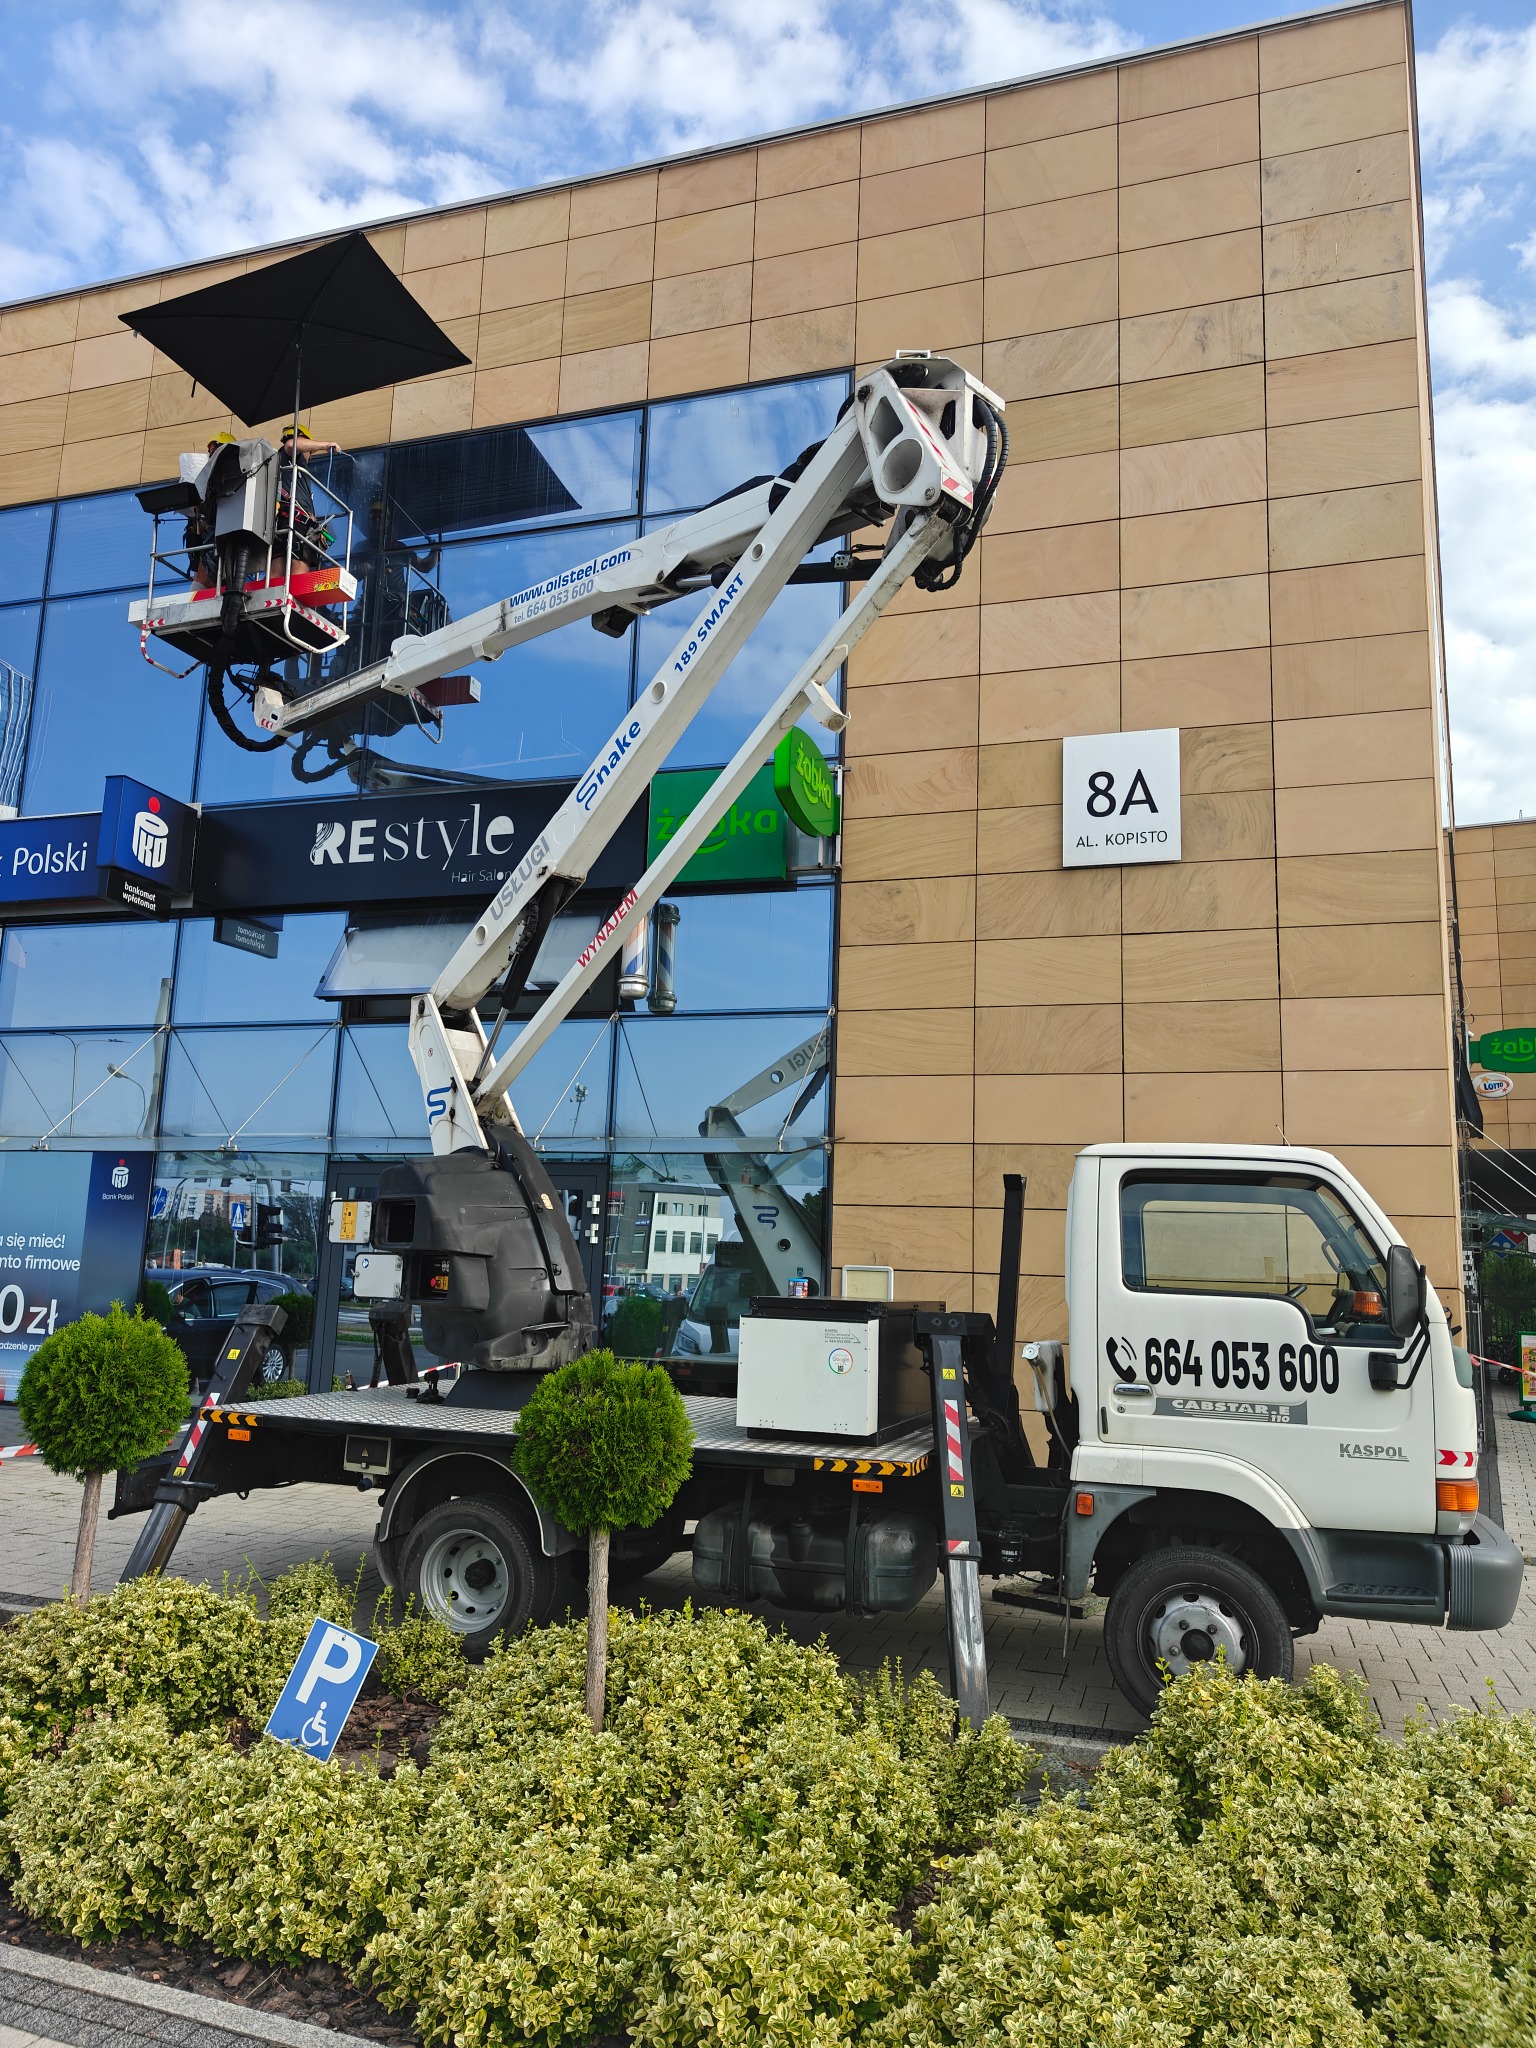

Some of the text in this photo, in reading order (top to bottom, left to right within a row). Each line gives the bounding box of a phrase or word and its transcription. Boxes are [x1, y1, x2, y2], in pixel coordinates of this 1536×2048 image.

[509, 550, 631, 608] www.oilsteel.com
[514, 579, 594, 624] tel. 664 053 600
[674, 572, 744, 673] 189 SMART
[576, 721, 642, 812] Snake
[797, 741, 832, 809] żabka
[1086, 768, 1159, 818] 8A
[132, 811, 169, 869] PKO
[656, 804, 778, 841] żka
[1075, 830, 1168, 848] AL. KOPISTO
[12, 842, 88, 876] Polski
[451, 868, 512, 883] Hair Salon
[124, 881, 156, 902] bankomat
[490, 835, 551, 921] USŁUGI
[122, 891, 157, 911] wpłatomat
[577, 888, 639, 968] WYNAJEM
[1490, 1037, 1536, 1055] żab
[1484, 1082, 1503, 1090] LOTTO
[6, 1232, 26, 1250] się
[28, 1233, 66, 1248] mieć!
[25, 1254, 80, 1271] firmowe
[26, 1298, 58, 1335] zł
[1145, 1337, 1339, 1394] 664 053 600
[1271, 1415, 1290, 1423] 110
[1339, 1443, 1409, 1460] KASPOL
[295, 1626, 363, 1705] P
